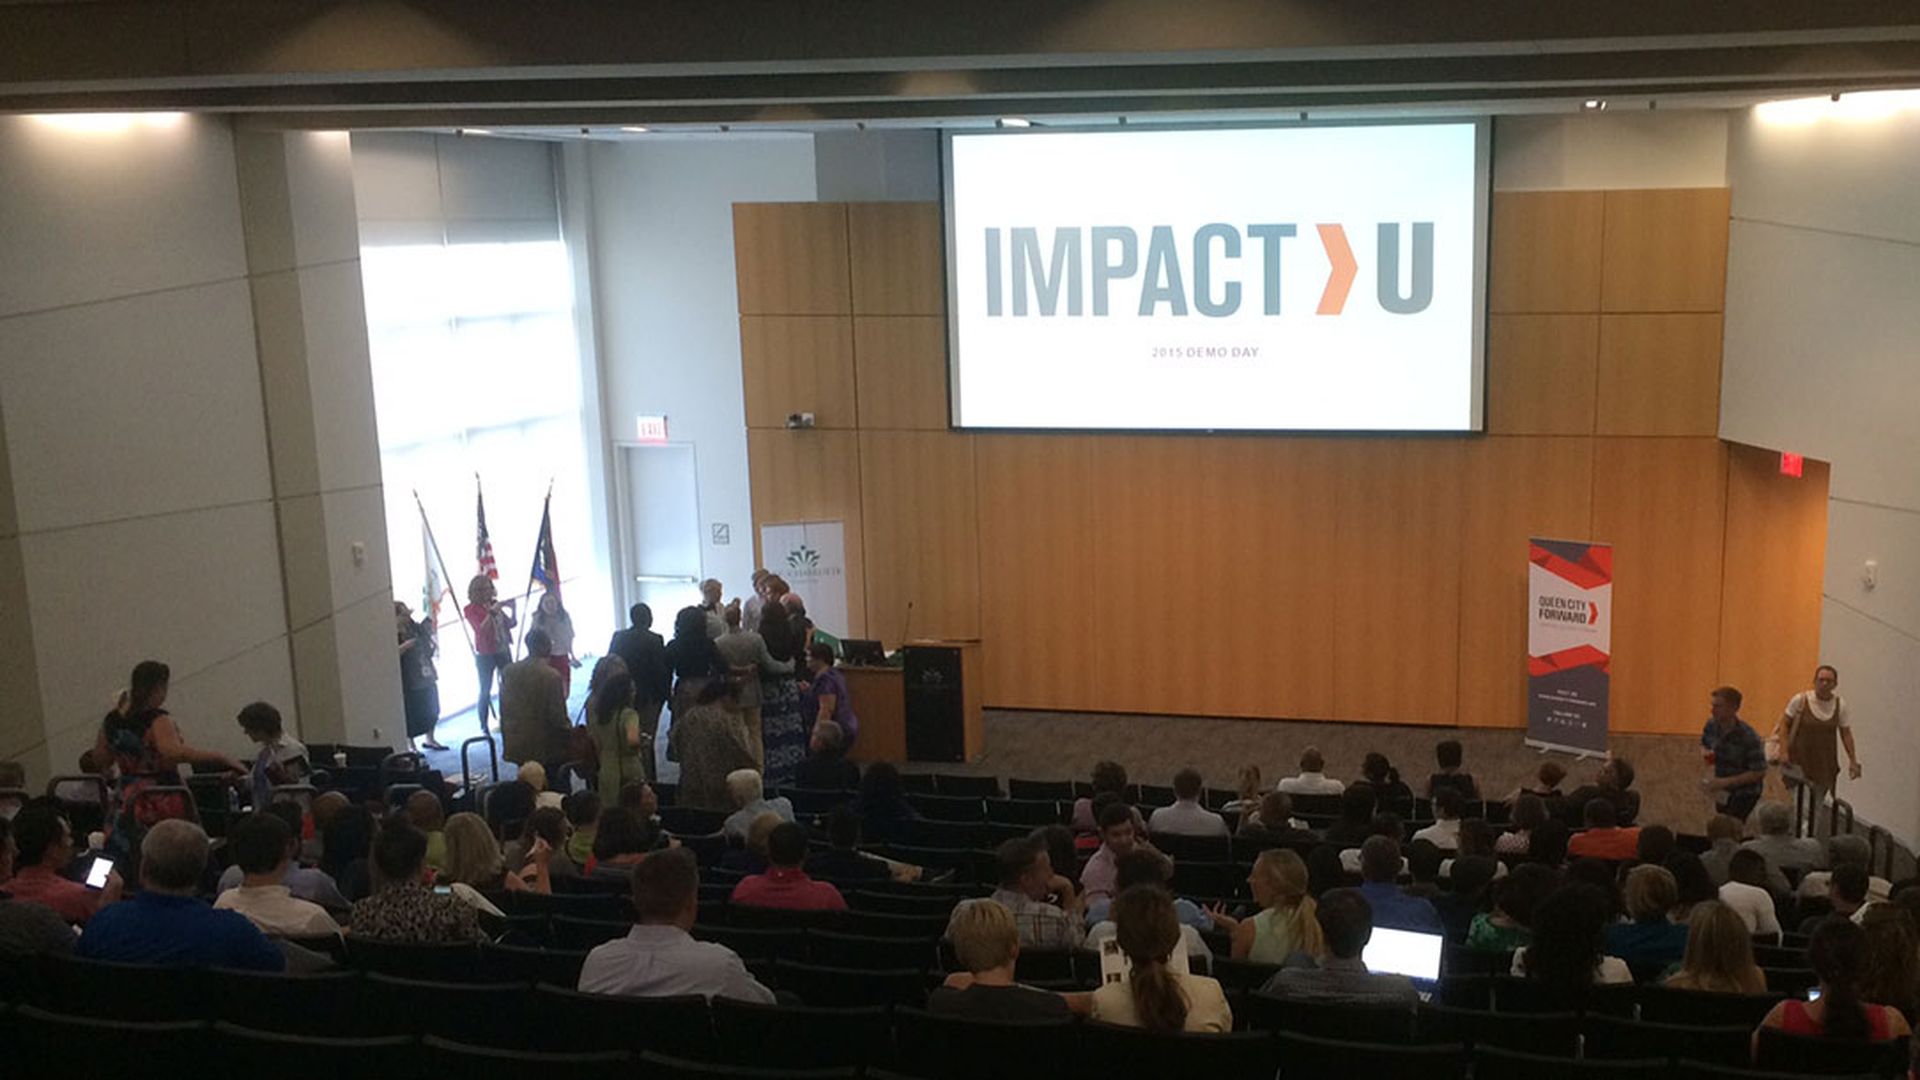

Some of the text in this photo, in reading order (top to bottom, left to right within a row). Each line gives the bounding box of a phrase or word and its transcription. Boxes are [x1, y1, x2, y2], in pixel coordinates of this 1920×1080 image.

[985, 222, 1435, 318] IMPACT U
[1151, 347, 1183, 358] 2015
[1186, 346, 1228, 358] DEMO
[1539, 595, 1586, 611] QUEEN CITY
[1539, 608, 1586, 624] FORWARD
